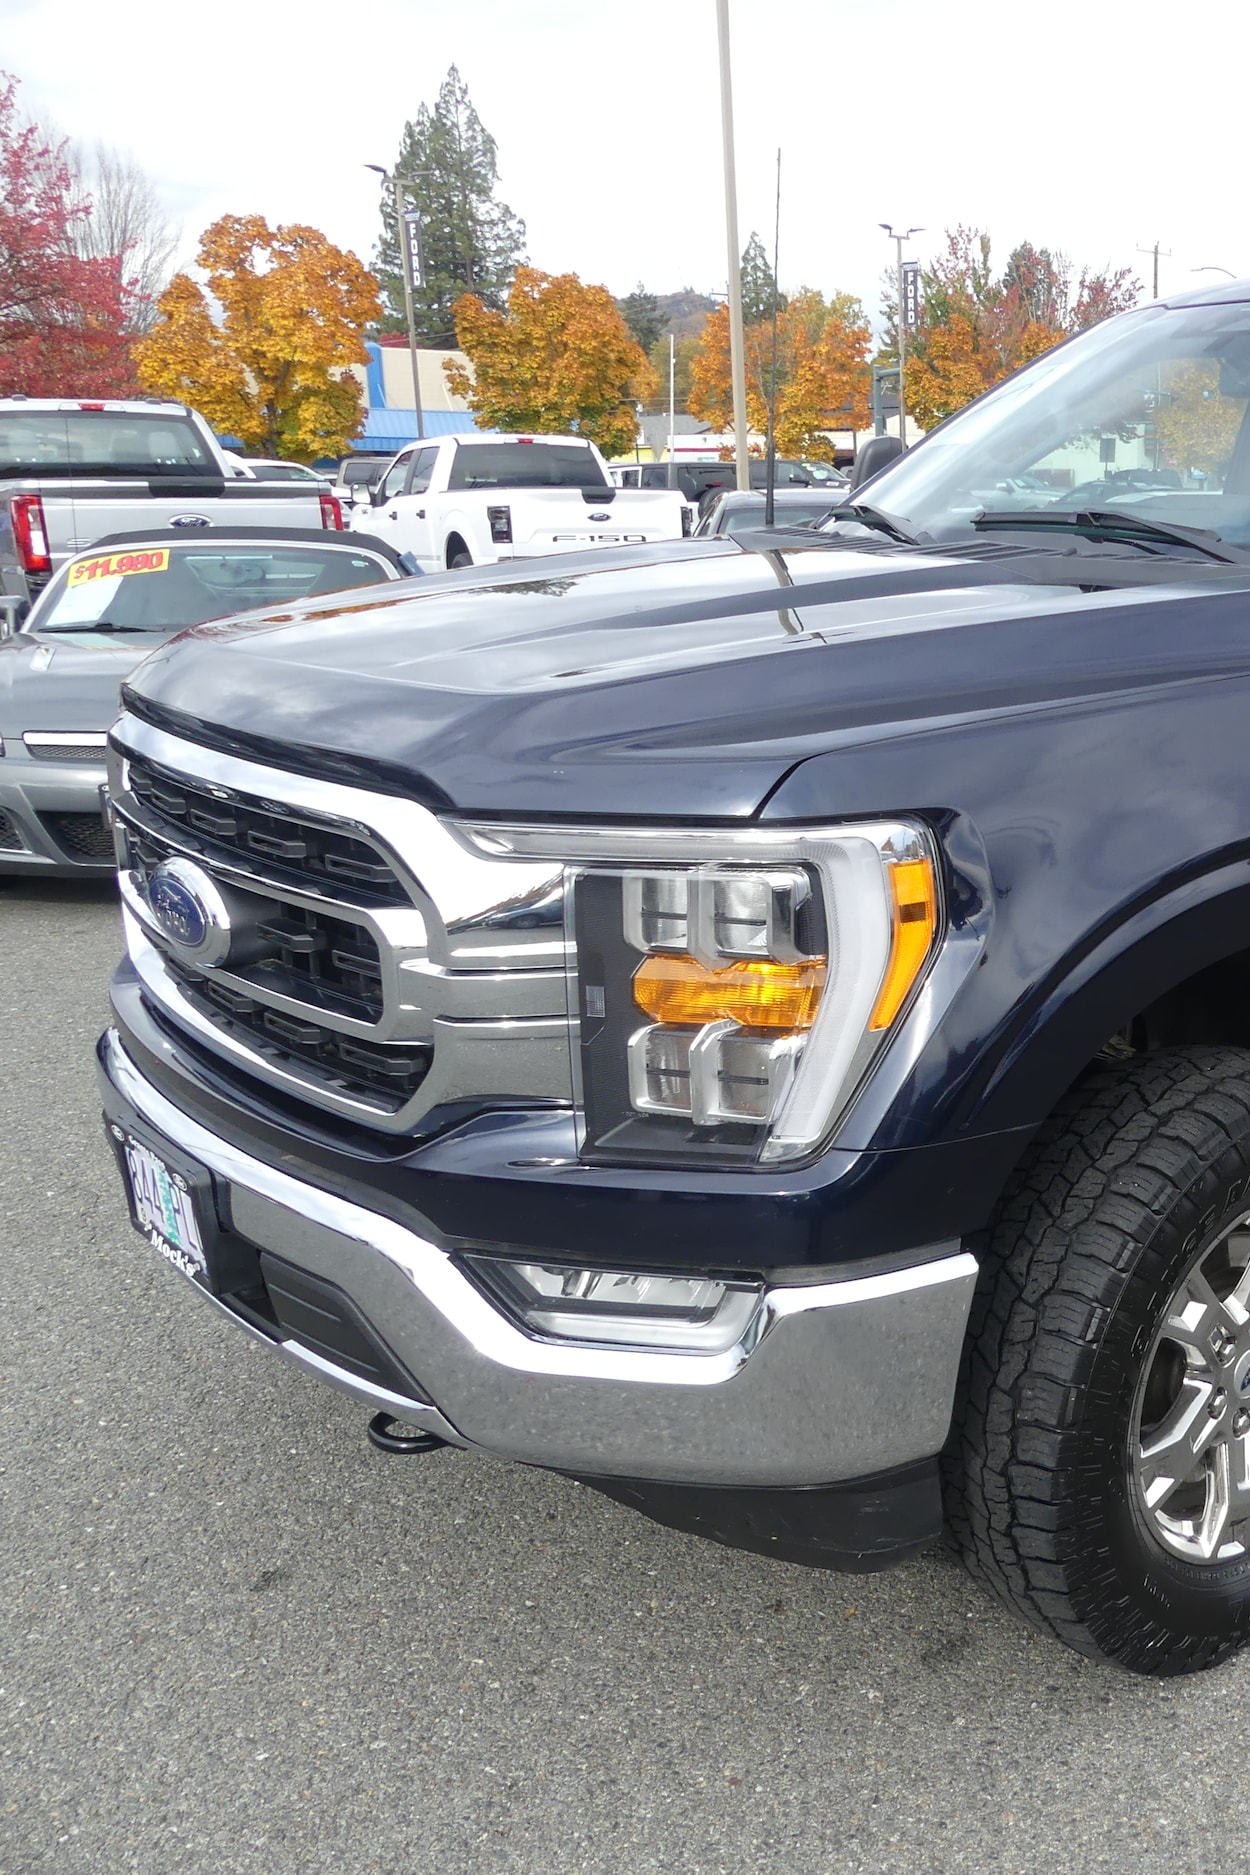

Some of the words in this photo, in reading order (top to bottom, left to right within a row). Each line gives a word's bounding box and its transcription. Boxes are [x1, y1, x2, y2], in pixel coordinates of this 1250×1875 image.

[906, 271, 916, 325] FORD
[551, 534, 647, 543] F-150
[150, 1229, 196, 1277] Mock's
